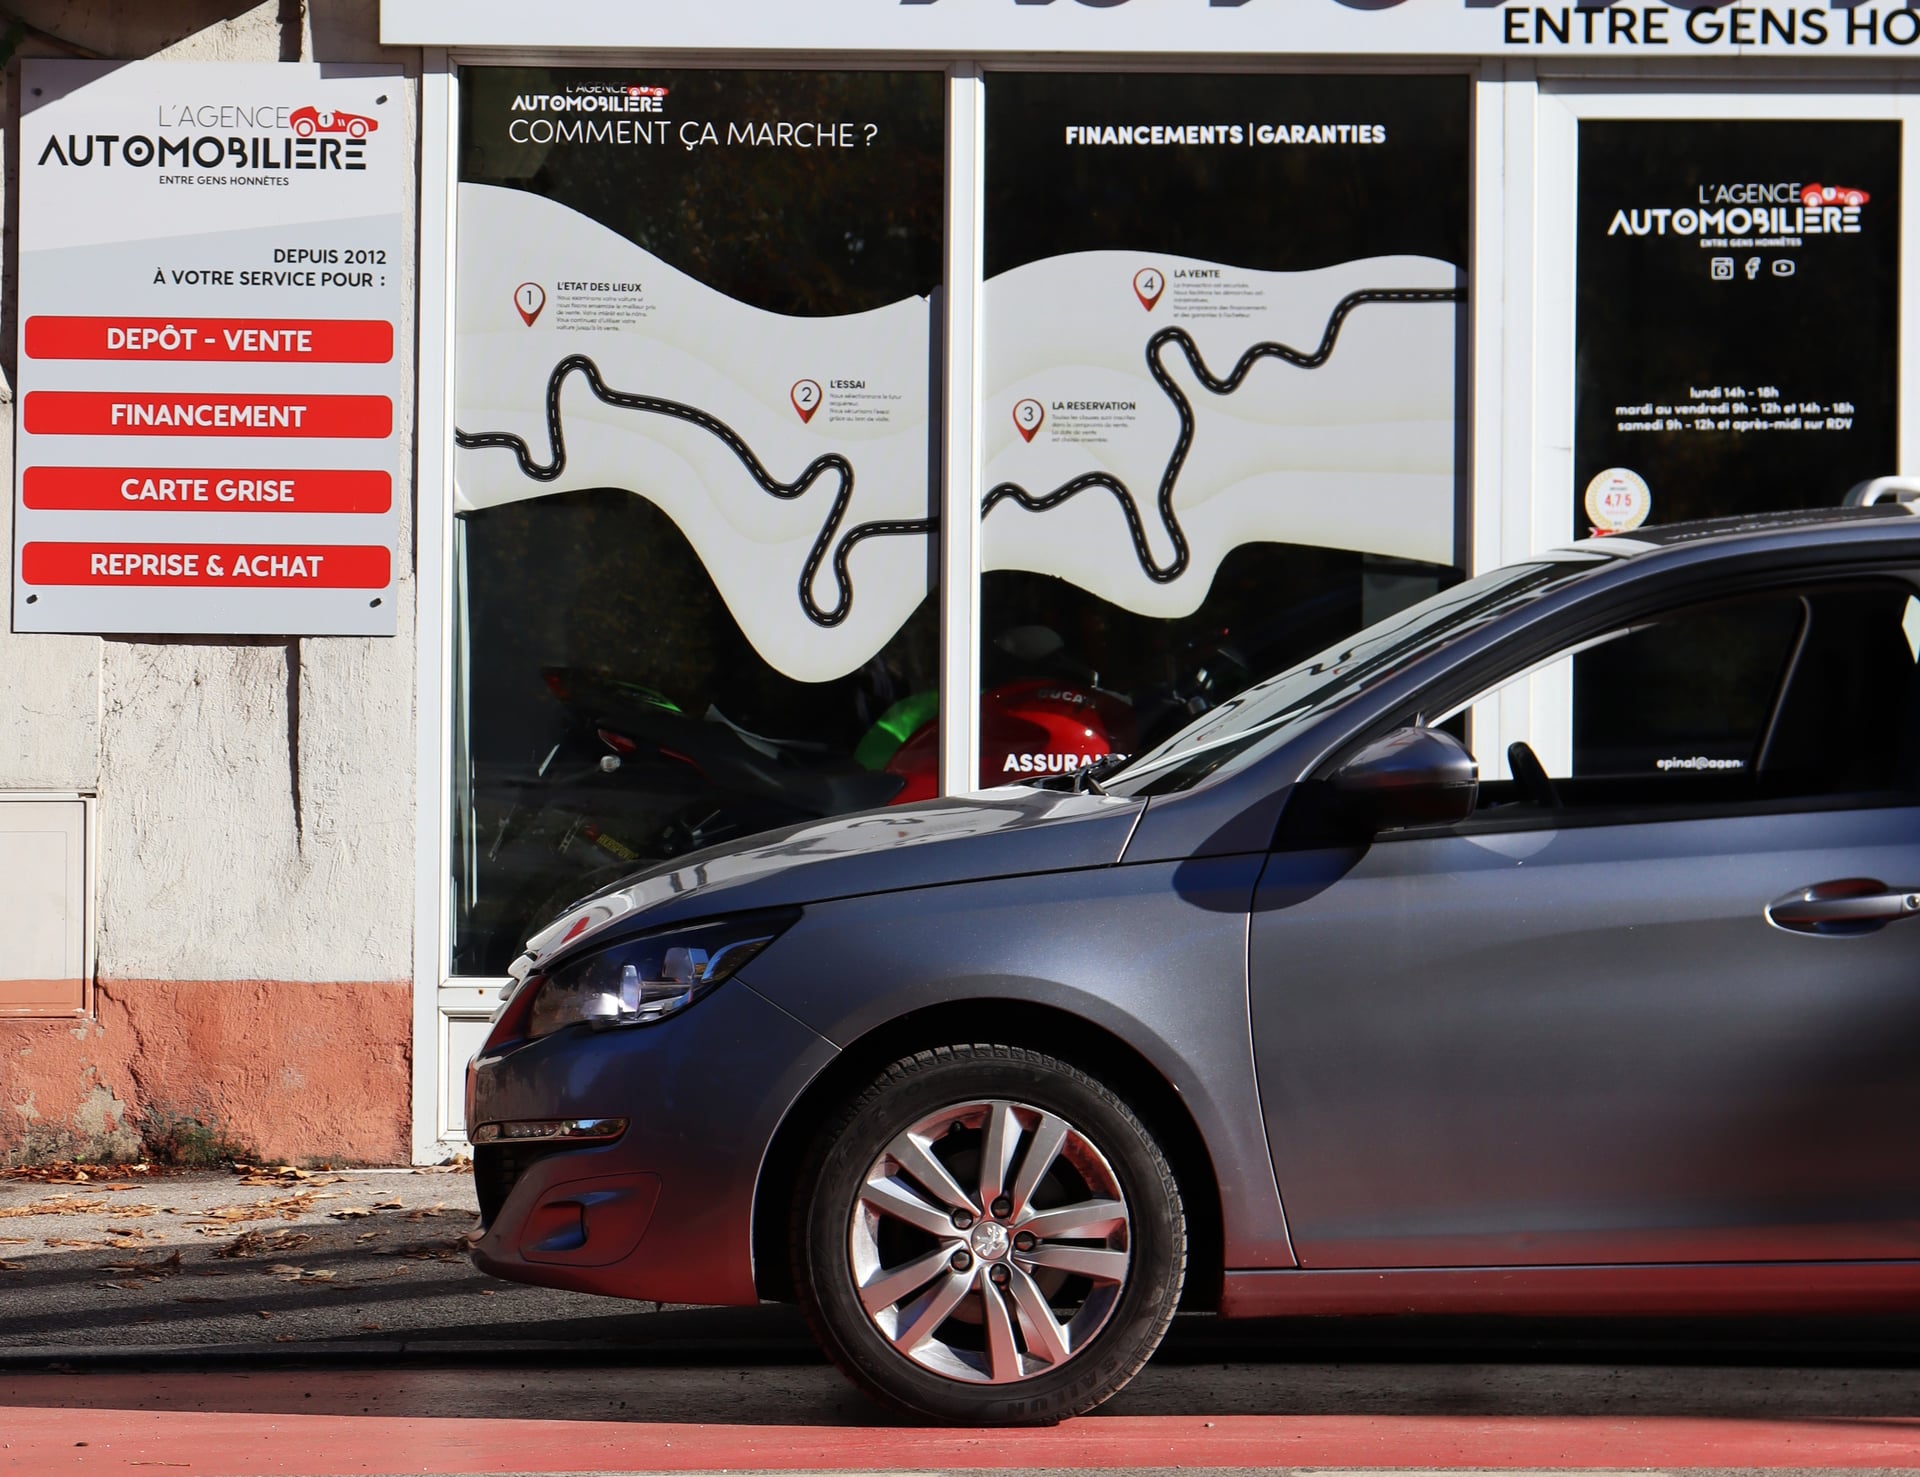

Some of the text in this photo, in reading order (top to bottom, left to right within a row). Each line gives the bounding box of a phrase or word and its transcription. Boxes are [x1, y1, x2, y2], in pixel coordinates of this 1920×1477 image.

[1504, 7, 1669, 44] ENTRE
[1685, 7, 1828, 45] GENS
[508, 119, 879, 151] COMMENT ÇA MARCHE ?
[1065, 124, 1387, 145] FINANCEMENTS GARANTIES
[159, 175, 289, 186] ENTRE GENS HONNÊTES
[274, 249, 386, 265] DEPUIS 2012
[153, 266, 166, 285] À
[172, 270, 234, 286] VOTRE
[239, 271, 316, 287] SERVICE
[321, 271, 373, 287] POUR
[1174, 269, 1220, 278] LA VENTE
[557, 282, 642, 292] L'ETAT DES LIEUX
[1144, 276, 1154, 290] 4
[107, 324, 197, 351] DEPÔT
[223, 329, 312, 352] VENTE
[830, 380, 866, 389] L'ESSAI
[1690, 386, 1722, 399] lundi
[1723, 386, 1745, 398] 14h
[801, 386, 812, 402] 2
[1023, 406, 1034, 422] 3
[1052, 402, 1136, 410] LA RESERVATION
[1615, 403, 1653, 415] mardi
[1655, 406, 1673, 415] au
[1674, 402, 1730, 415] vendredi
[1732, 402, 1749, 415] 9h
[1760, 402, 1782, 414] 12h
[1783, 403, 1797, 414] et
[1799, 402, 1821, 414] 14h
[111, 404, 307, 428] FINANCEMENT
[1617, 419, 1664, 431] samedi
[1665, 419, 1683, 431] 9h
[1694, 419, 1715, 430] 12h
[1717, 419, 1731, 430] et
[1732, 418, 1802, 432] après-midi
[1803, 421, 1825, 430] sur
[1826, 418, 1853, 430] RDV
[120, 479, 295, 502] CARTE GRISE
[90, 553, 323, 577] REPRISE & ACHAT
[1003, 753, 1132, 772] ASSURA
[1656, 756, 1744, 771] epinal@agen
